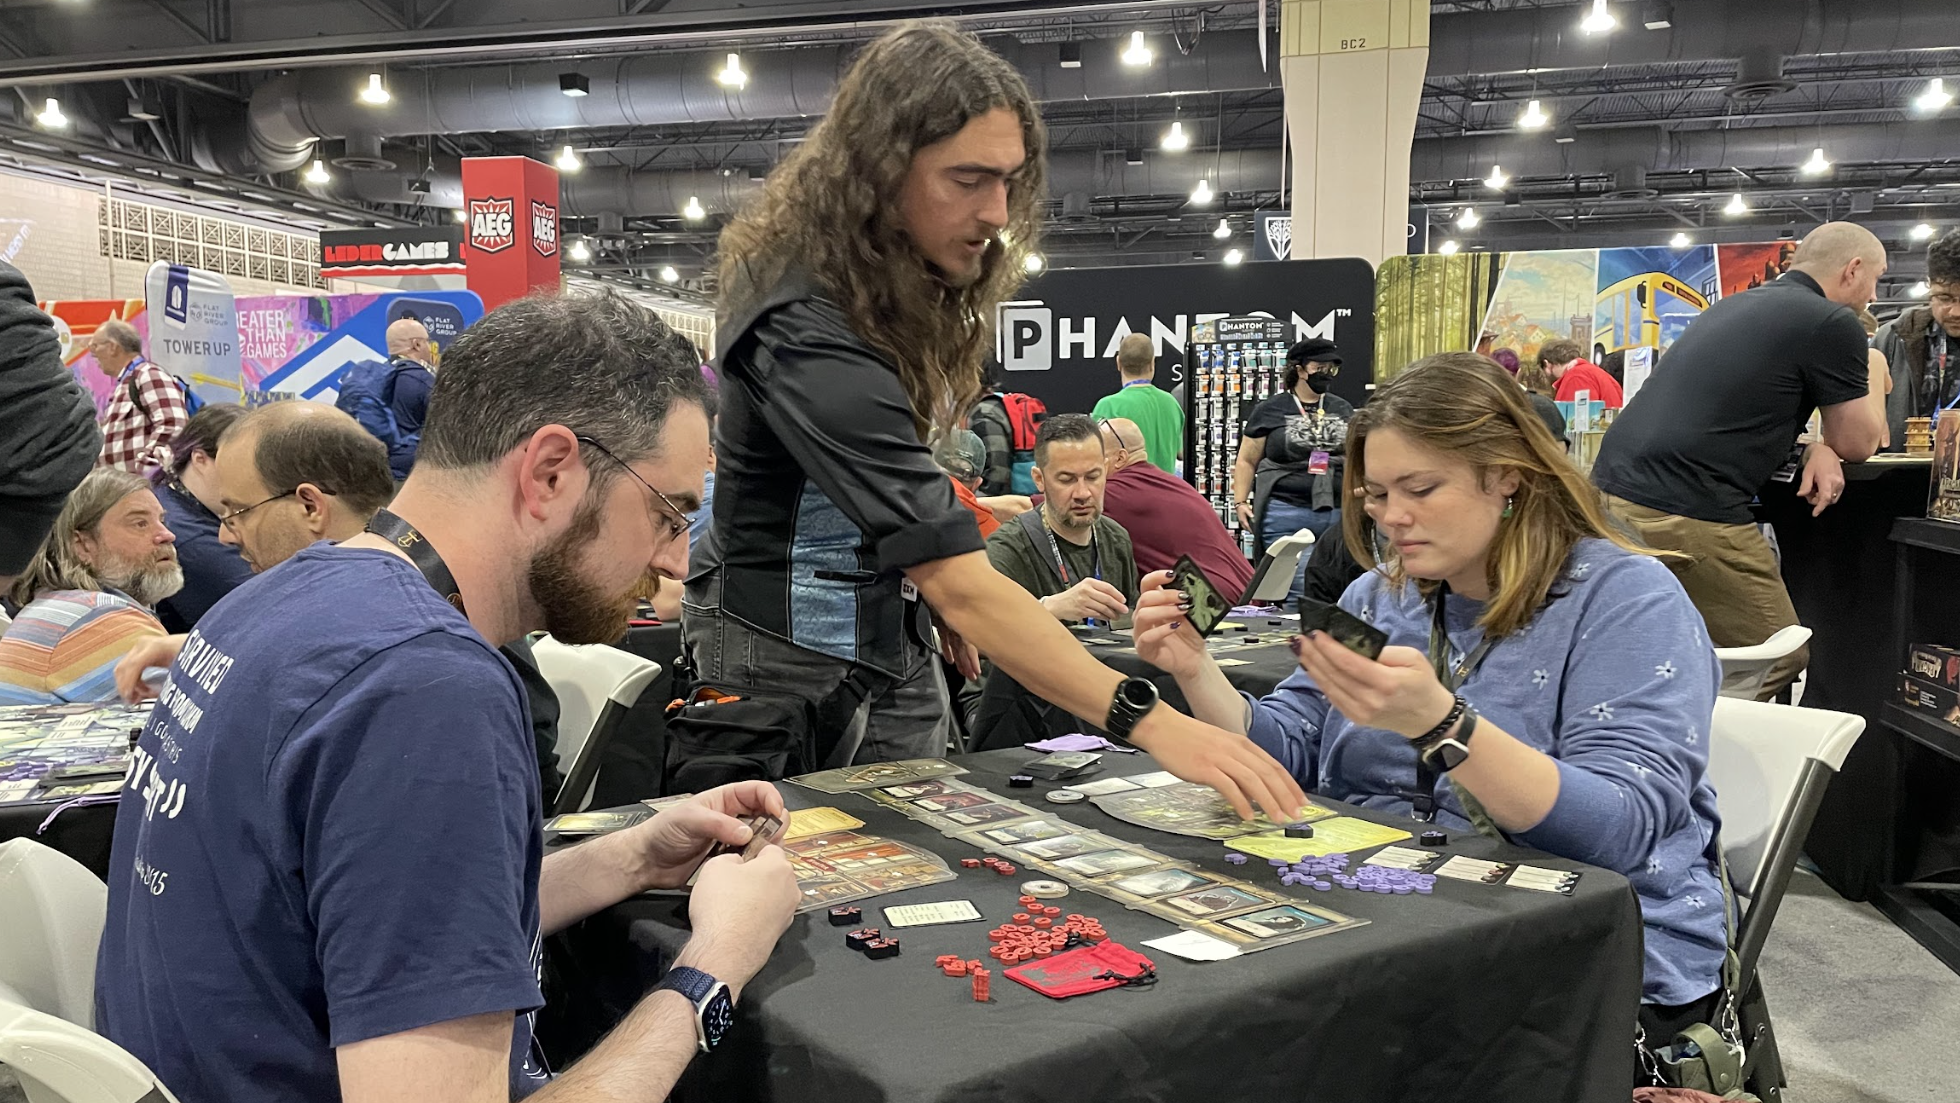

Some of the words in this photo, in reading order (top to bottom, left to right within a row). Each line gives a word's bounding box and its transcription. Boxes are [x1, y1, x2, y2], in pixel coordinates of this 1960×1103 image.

[1341, 38, 1366, 50] BC2
[472, 212, 512, 237] AEG
[533, 216, 556, 242] AEG
[246, 328, 286, 343] THAN
[163, 339, 211, 356] TOWER
[213, 342, 231, 356] UP
[246, 342, 287, 358] GAMES
